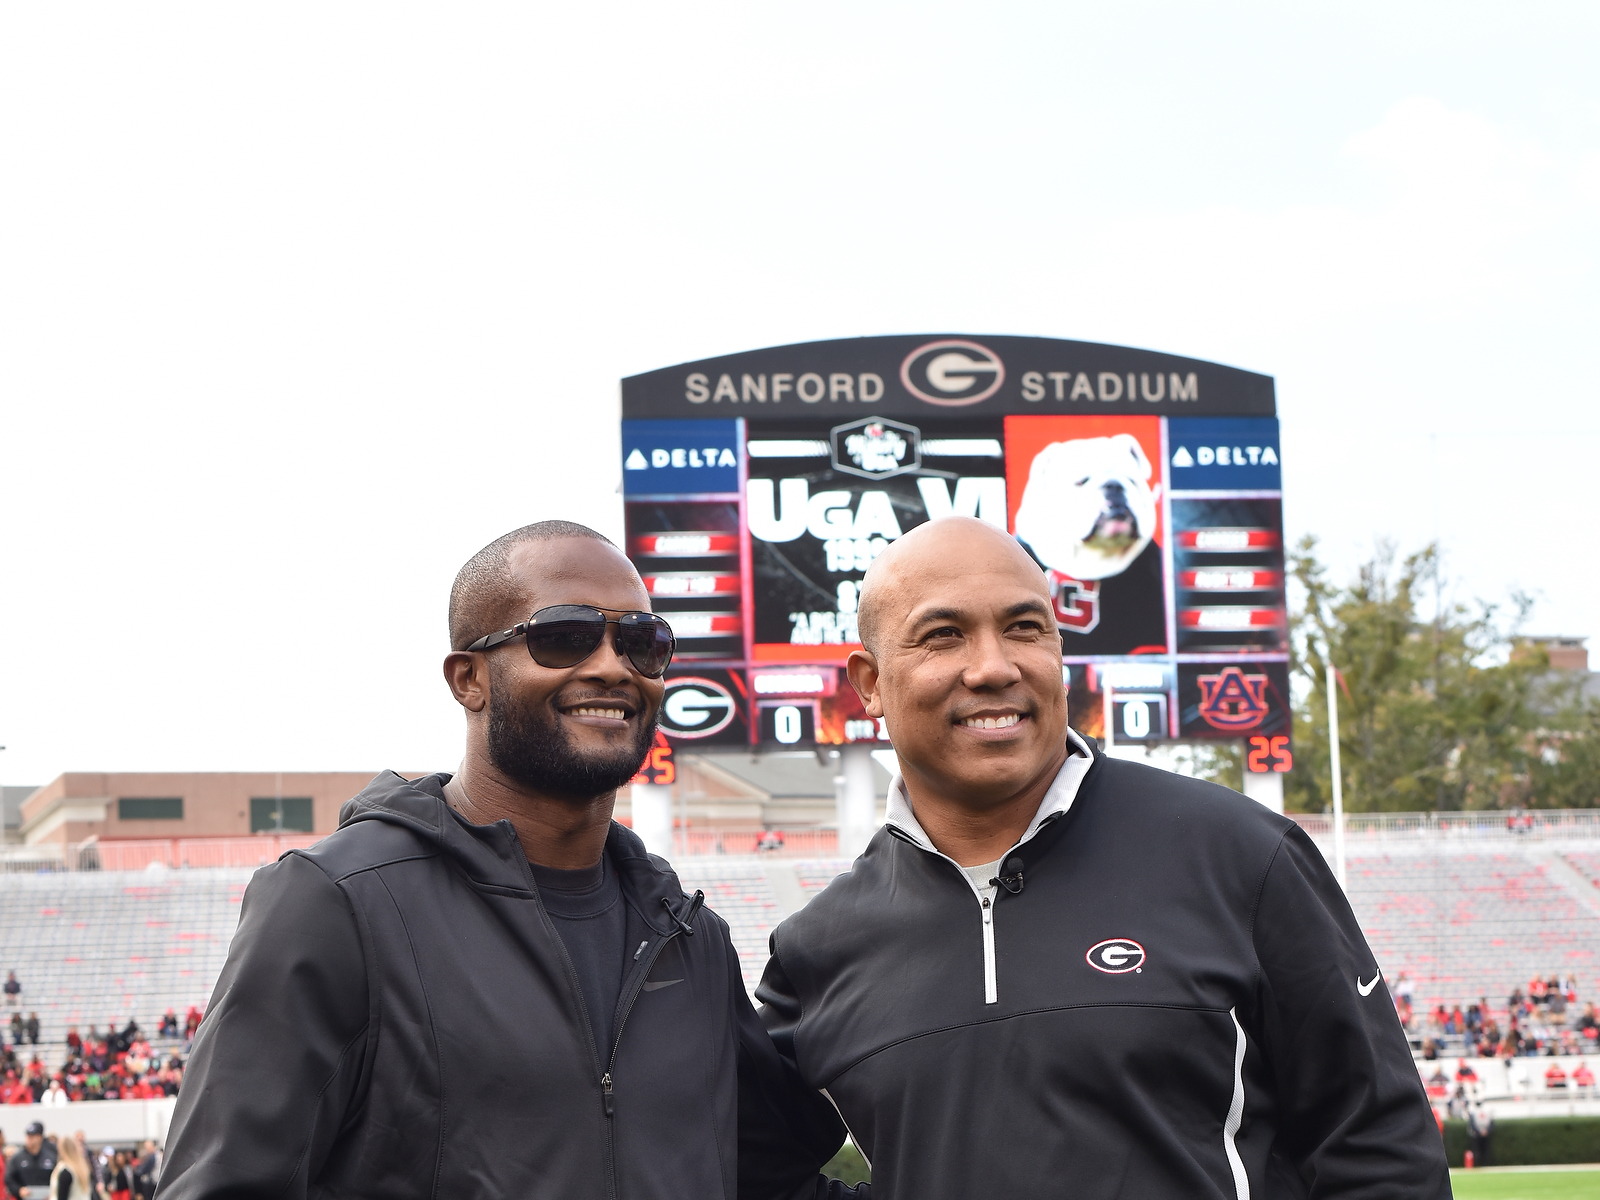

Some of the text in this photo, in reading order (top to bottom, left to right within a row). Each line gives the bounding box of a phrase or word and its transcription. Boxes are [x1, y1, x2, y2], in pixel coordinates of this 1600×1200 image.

[685, 370, 1199, 402] SANFORD STADIUM
[651, 448, 737, 468] DELTA
[1196, 446, 1278, 466] DELTA
[774, 705, 802, 744] 0
[1123, 701, 1150, 738] 0
[1248, 735, 1293, 773] 25
